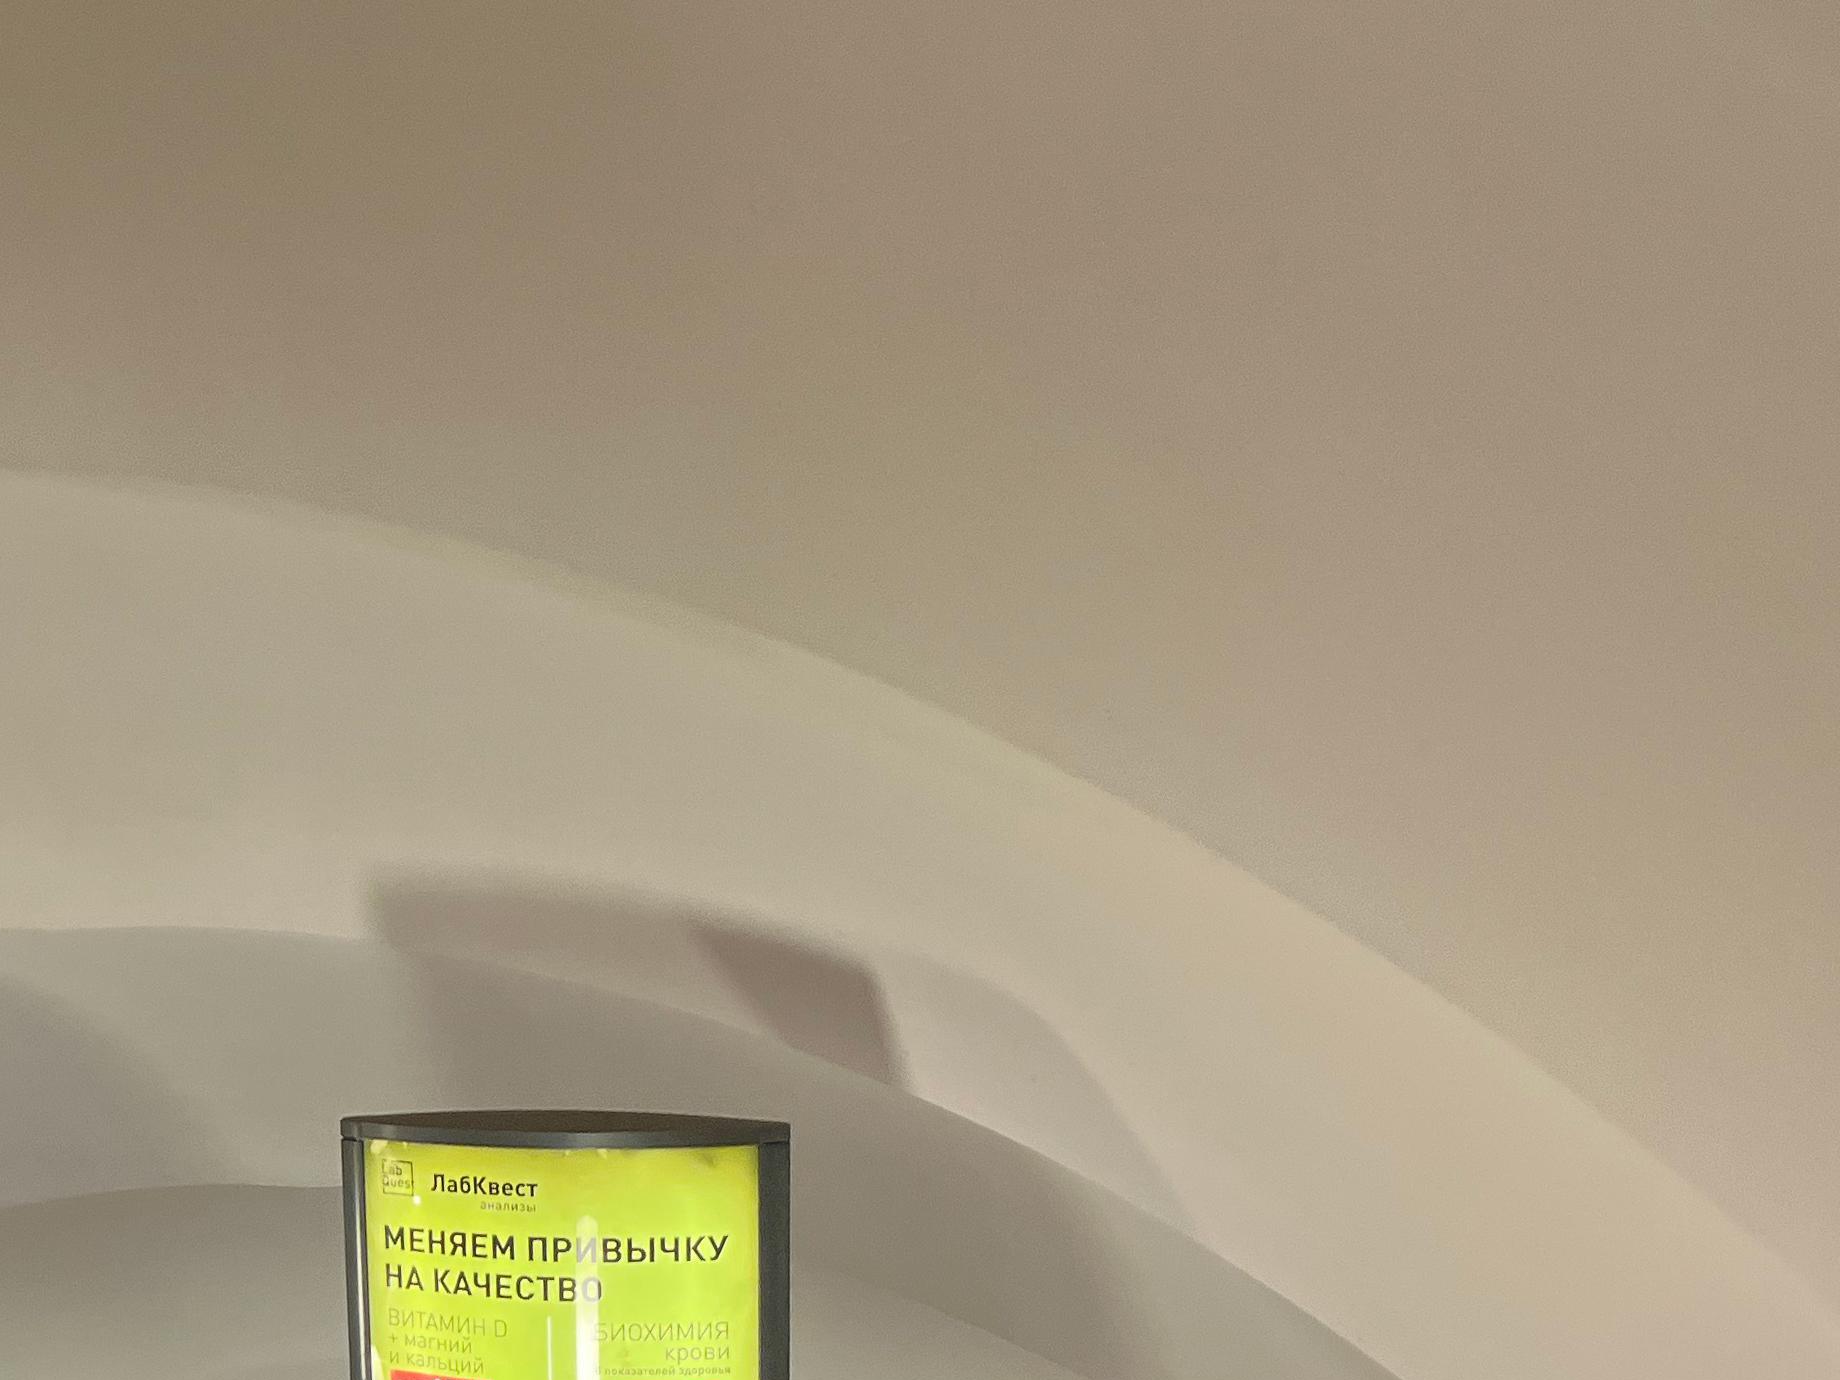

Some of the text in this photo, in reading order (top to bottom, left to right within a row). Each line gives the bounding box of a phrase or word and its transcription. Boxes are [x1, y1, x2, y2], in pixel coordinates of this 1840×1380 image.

[431, 1173, 538, 1198] ЛабКвест
[480, 1201, 537, 1213] анализы
[384, 1225, 728, 1263] МЕНЯЕМ ПРИВЫЧКУ
[385, 1263, 602, 1302] НА КАЧЕСТВО
[388, 1308, 508, 1338] ВИТАМИН D
[594, 1321, 730, 1341] БИОХИМИЯ
[405, 1335, 473, 1353] магний
[389, 1351, 484, 1375] и кальций
[664, 1346, 730, 1365] крови
[604, 1366, 676, 1377] показателей
[679, 1366, 732, 1378] здоровья
